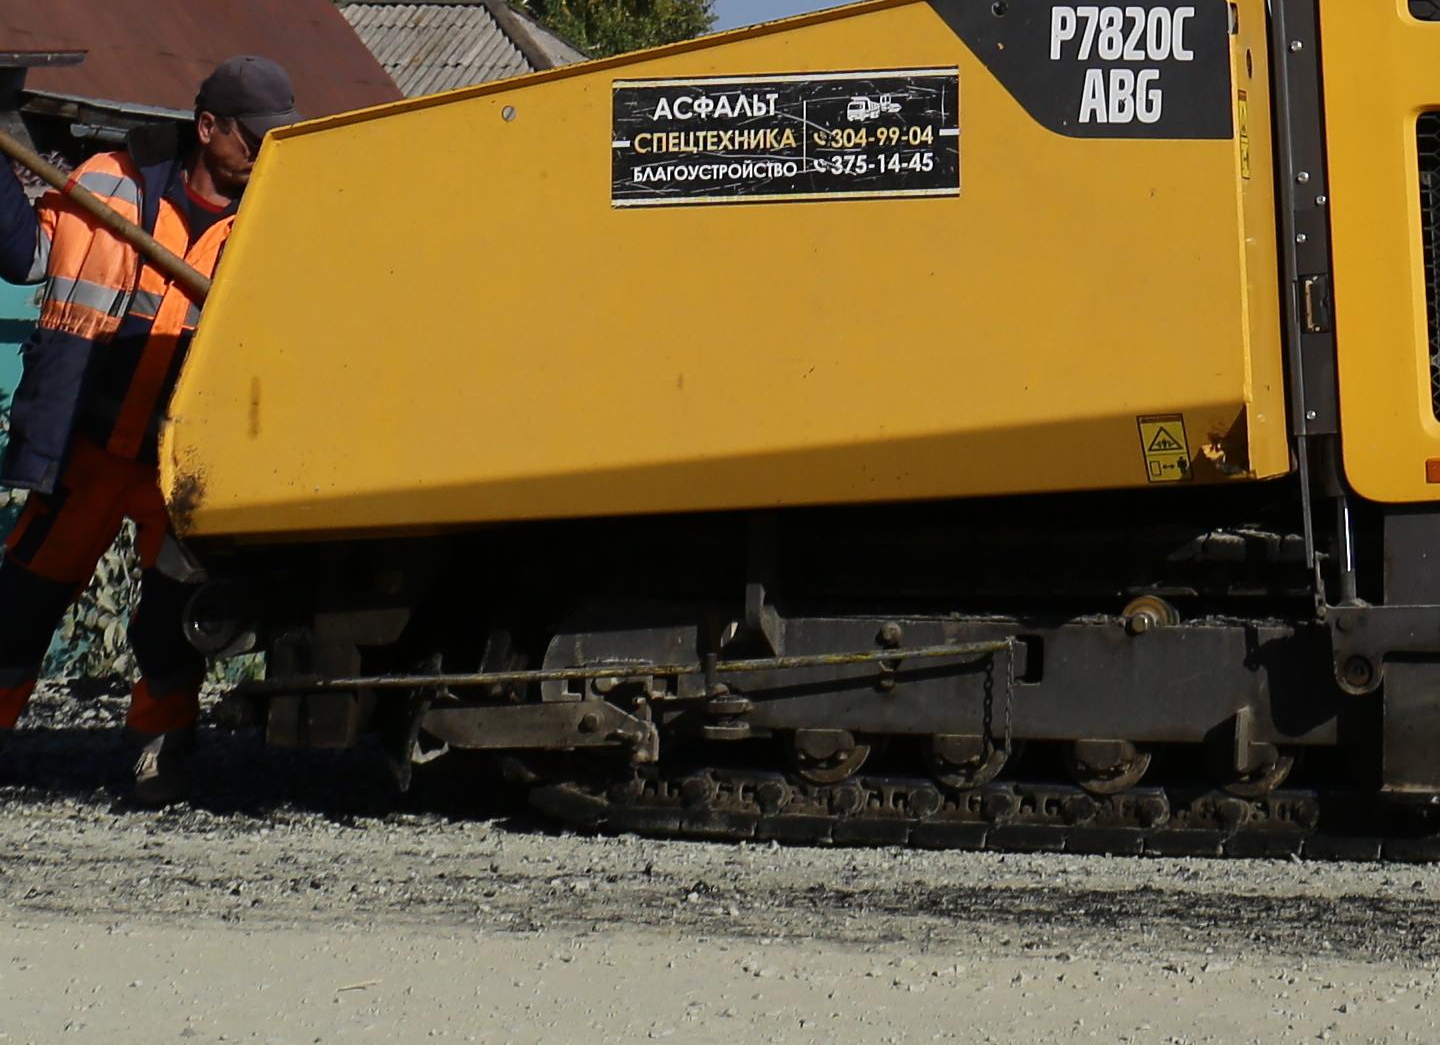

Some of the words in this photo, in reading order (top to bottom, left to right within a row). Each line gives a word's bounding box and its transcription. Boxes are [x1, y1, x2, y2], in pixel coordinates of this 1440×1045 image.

[1050, 6, 1195, 61] P7820C
[652, 93, 780, 121] АСФАЛЬТ
[1078, 68, 1163, 124] ABG
[634, 128, 798, 154] СПЕЦТЕХНИКА
[829, 124, 934, 148] 304-99-04
[633, 159, 799, 183] БЛАГОУСТРОЙСТВО
[829, 152, 934, 175] 375-14-45
